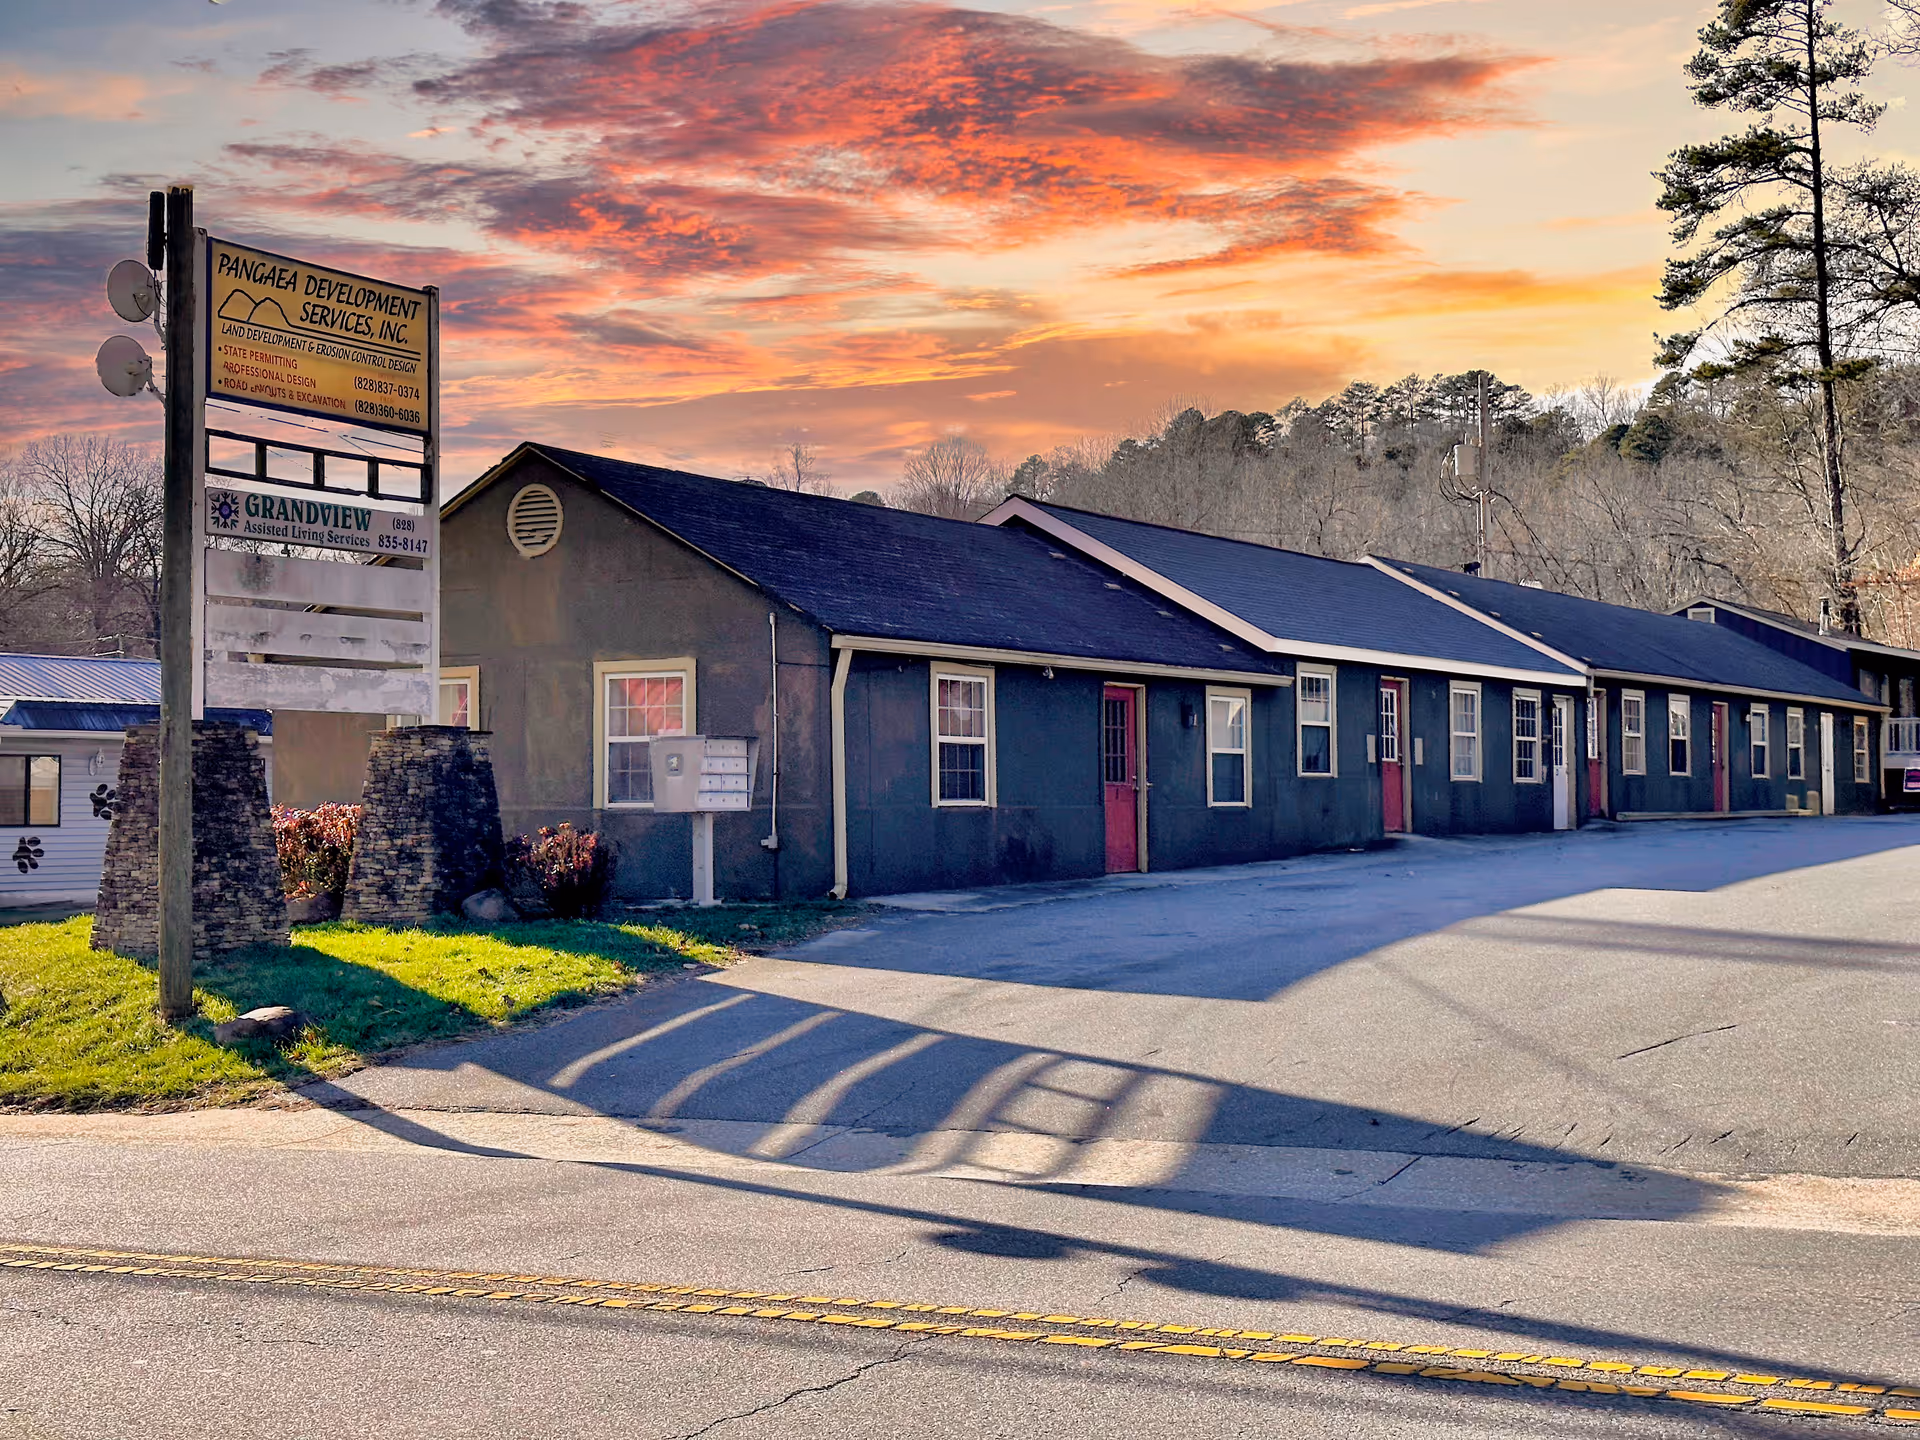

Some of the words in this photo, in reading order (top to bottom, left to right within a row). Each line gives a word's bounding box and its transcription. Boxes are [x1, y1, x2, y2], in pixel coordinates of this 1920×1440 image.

[218, 253, 298, 292] PANGAEA
[304, 275, 421, 320] DEVELOPMENT
[300, 302, 374, 339] SERVICES,
[379, 320, 408, 344] INC.
[222, 323, 245, 337] LAND
[247, 329, 307, 352] DEVELOPMENT
[308, 339, 315, 351] &
[316, 344, 350, 360] EROSION
[352, 351, 386, 368] CONTROL
[388, 359, 416, 374] DESIGN
[224, 345, 247, 359] STATE
[249, 349, 298, 369] PERMITTING
[224, 378, 247, 391] ROAD
[289, 390, 294, 400] &
[297, 391, 346, 410] EXCAVATION
[287, 374, 316, 389] DESIGN
[354, 376, 419, 400] (828)837-0374
[355, 399, 420, 423] (828)360-6036
[245, 493, 372, 532] GRANDVIEW
[392, 517, 415, 533] (828)
[244, 520, 288, 537] Assisted
[292, 525, 324, 544] Living
[327, 530, 370, 547] Services
[378, 534, 427, 553] 835-8147
